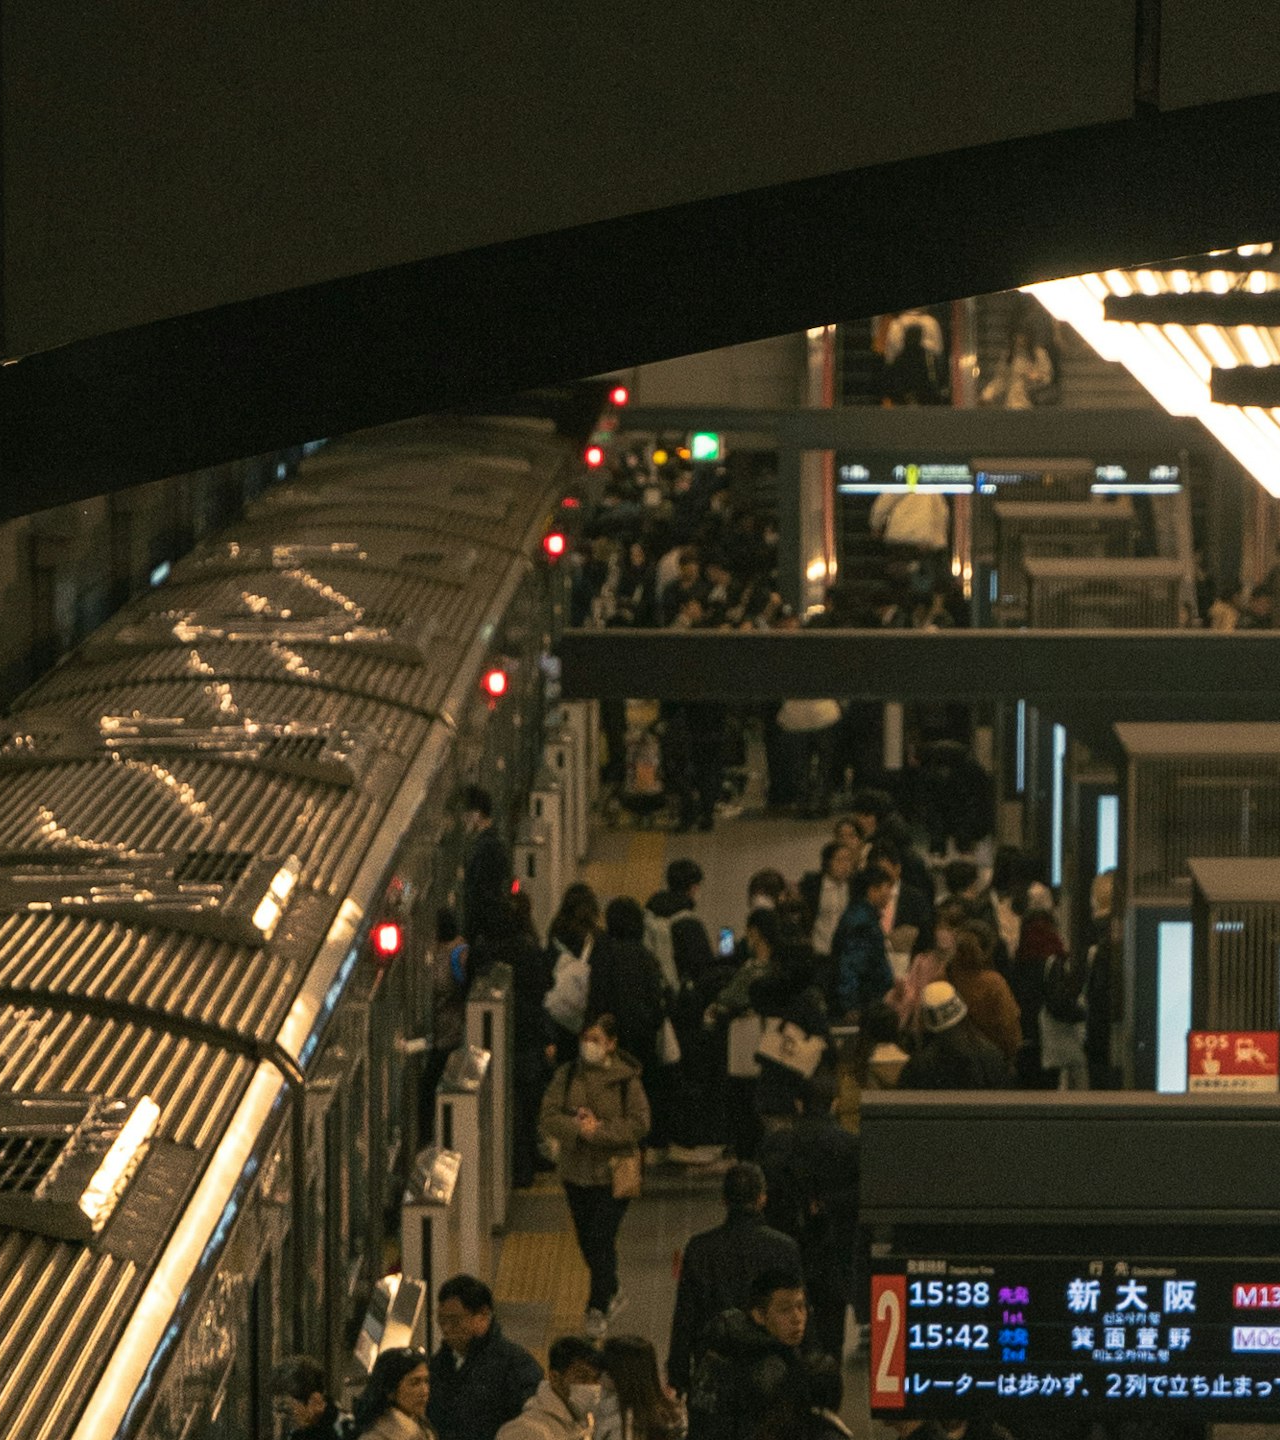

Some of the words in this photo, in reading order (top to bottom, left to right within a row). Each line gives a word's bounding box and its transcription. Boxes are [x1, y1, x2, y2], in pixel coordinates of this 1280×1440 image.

[1193, 1035, 1230, 1050] SOS
[909, 1281, 990, 1306] 15:38
[1067, 1279, 1197, 1312] 新大阪
[876, 1289, 901, 1394] 2
[909, 1324, 990, 1350] 15:42
